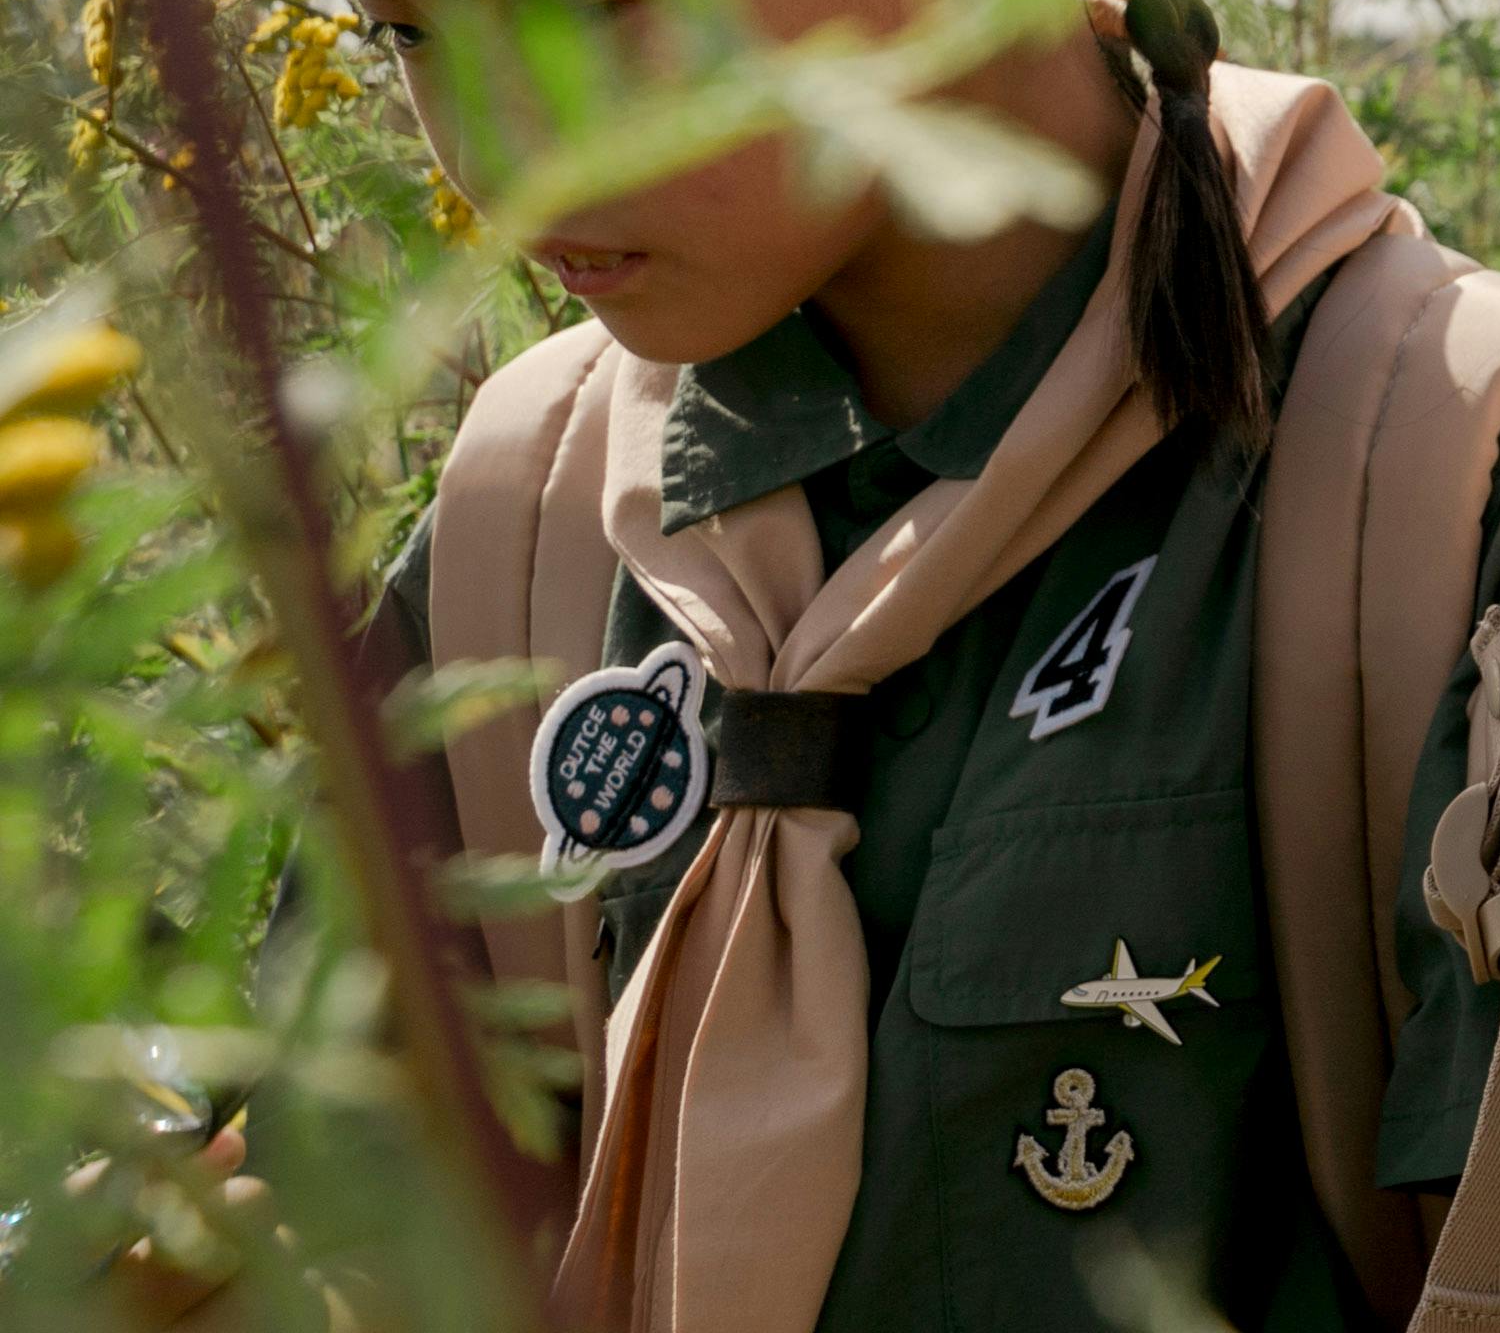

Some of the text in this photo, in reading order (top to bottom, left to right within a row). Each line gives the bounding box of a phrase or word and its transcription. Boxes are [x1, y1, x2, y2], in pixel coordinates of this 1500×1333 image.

[1026, 569, 1142, 721] 4
[584, 731, 618, 774] THE
[593, 730, 646, 809] WORLD
